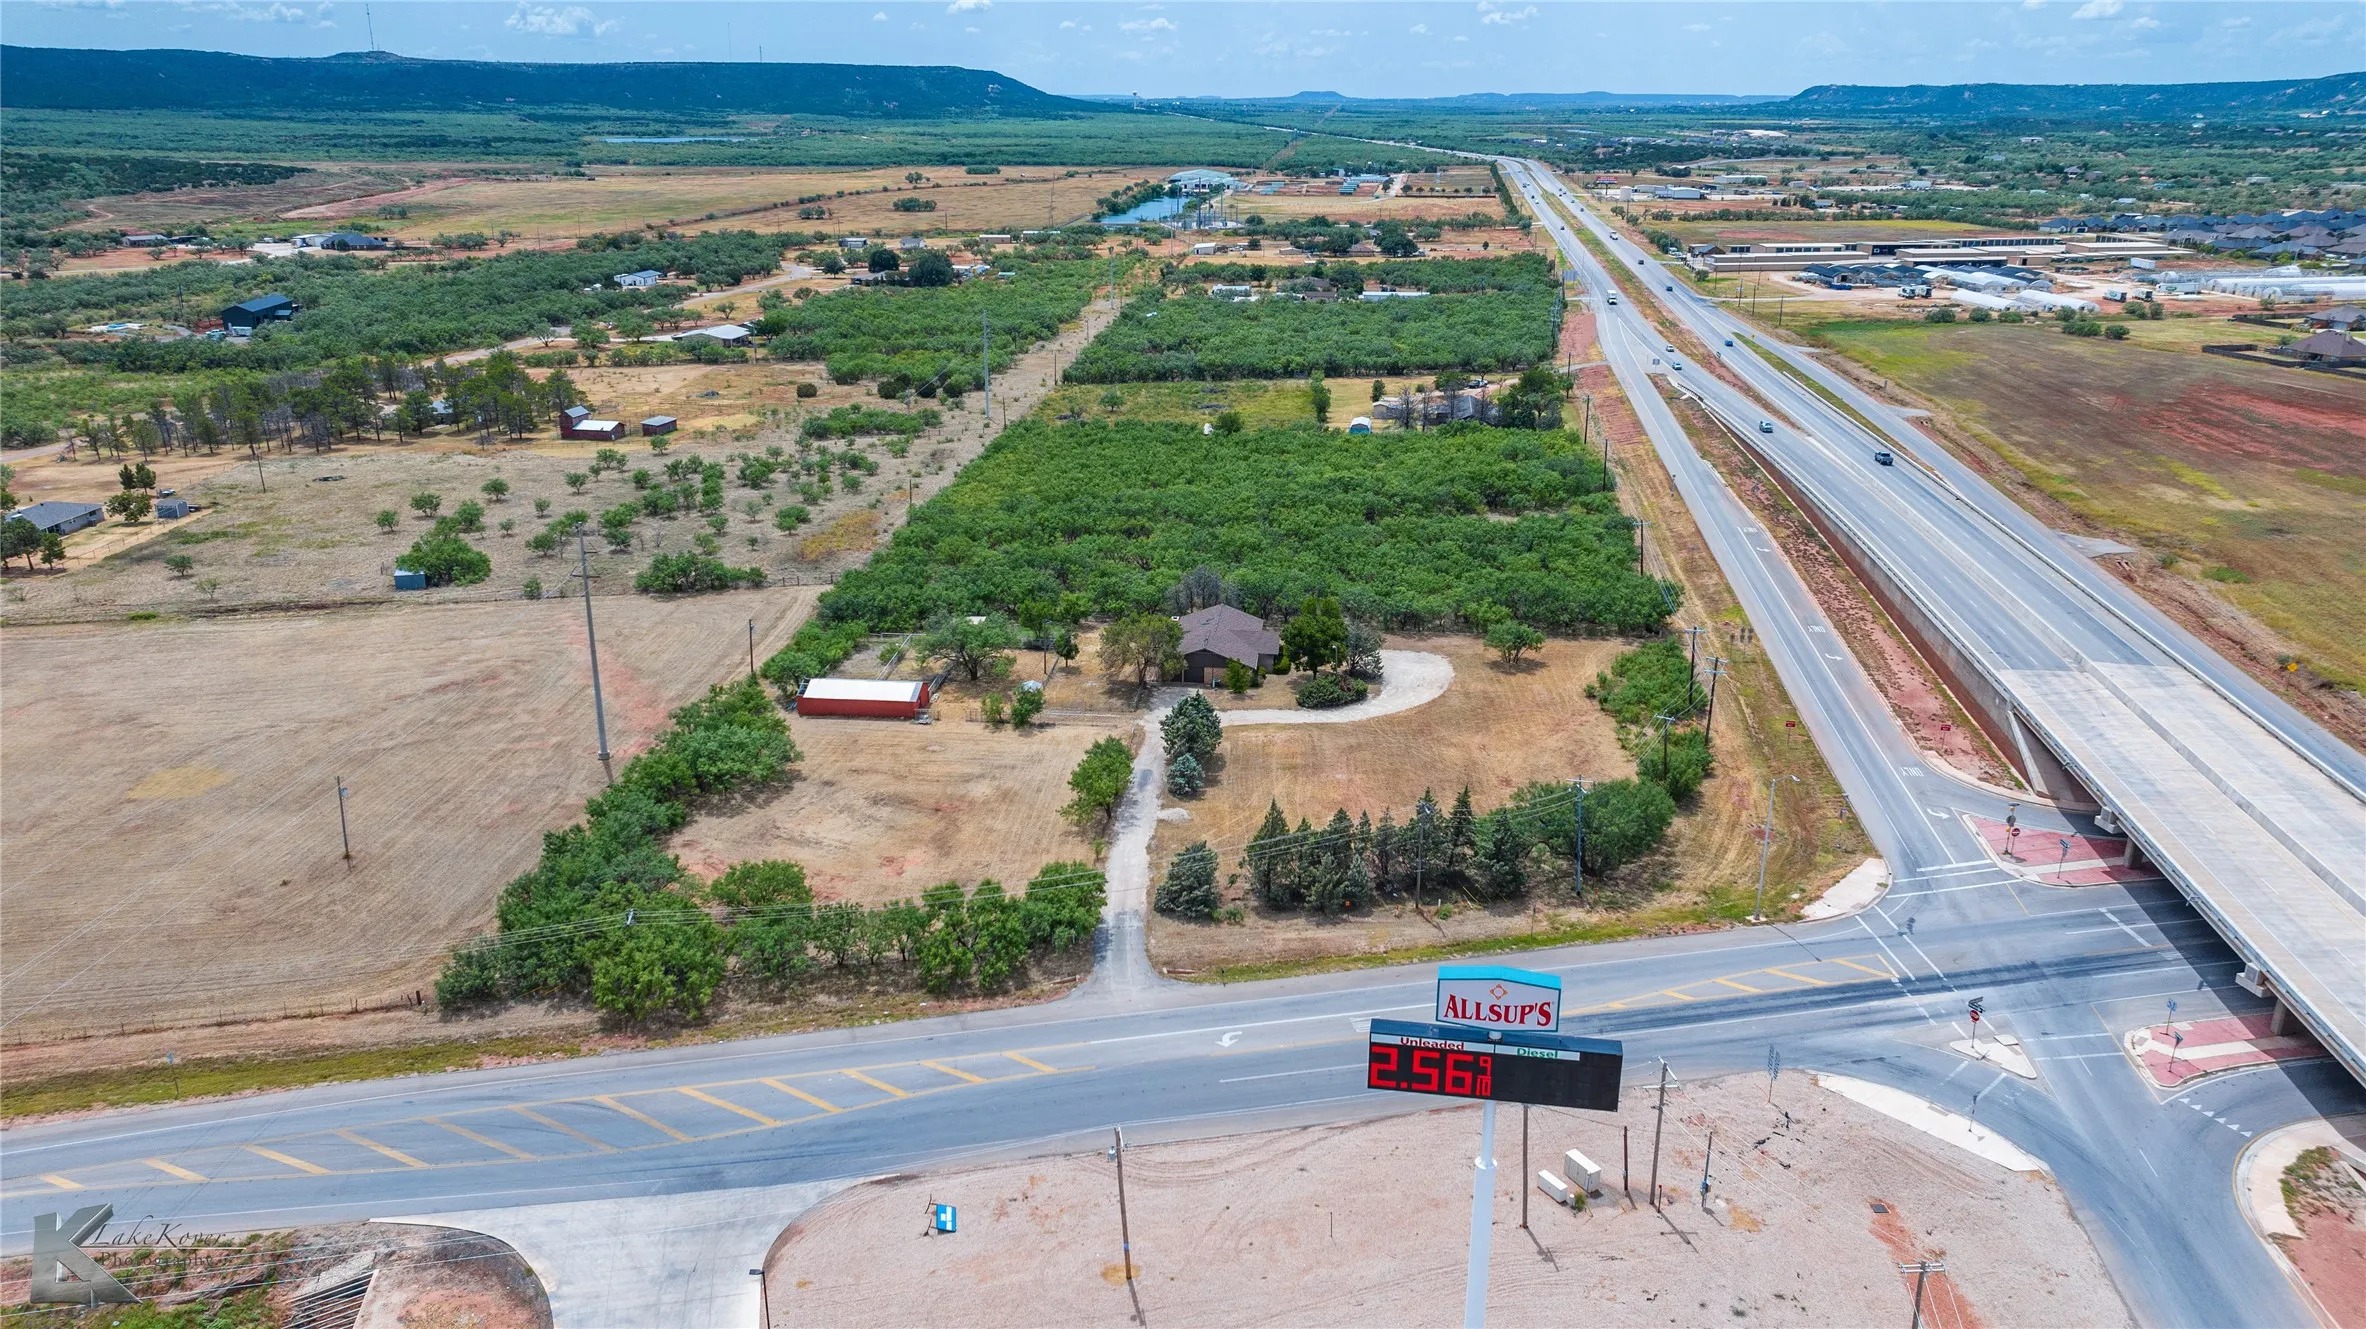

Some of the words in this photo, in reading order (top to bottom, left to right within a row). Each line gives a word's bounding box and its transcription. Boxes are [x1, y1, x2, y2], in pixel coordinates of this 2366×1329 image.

[1900, 766, 1925, 777] ONLY
[1443, 994, 1552, 1027] ALLSUP'S
[1400, 1037, 1464, 1050] Unleaded
[1517, 1047, 1558, 1059] Diesel
[1370, 1045, 1474, 1095] 2.56
